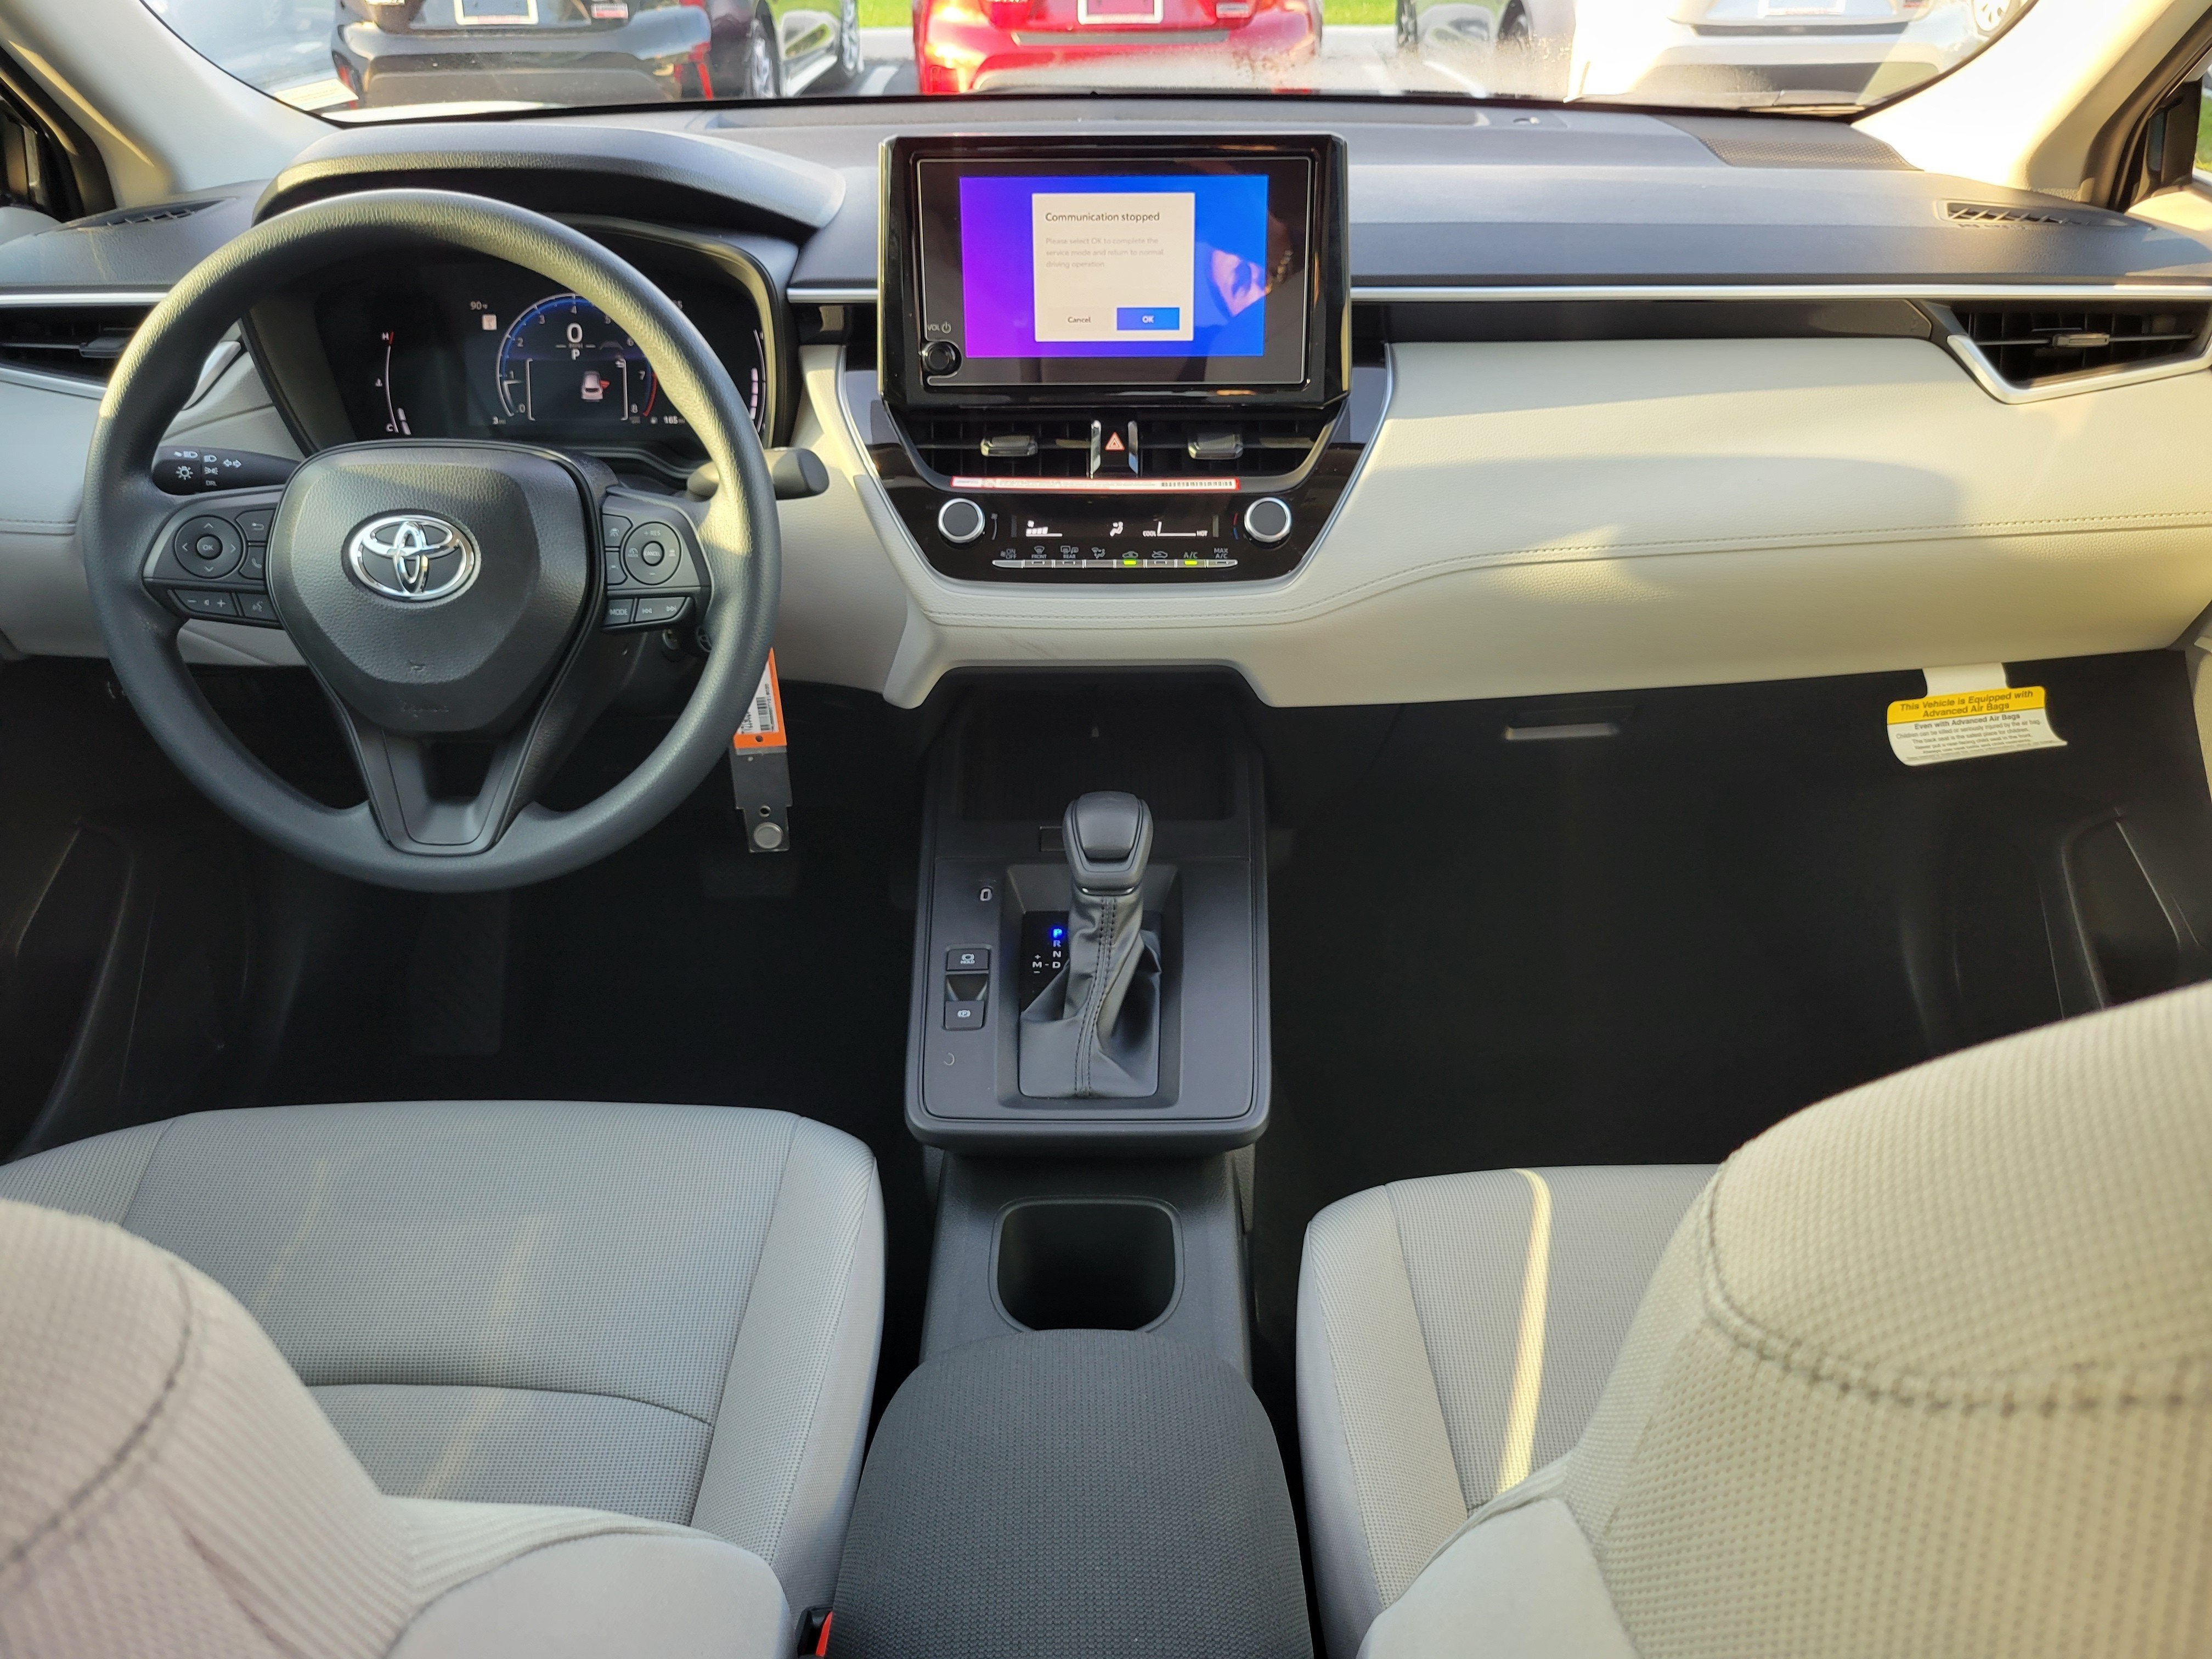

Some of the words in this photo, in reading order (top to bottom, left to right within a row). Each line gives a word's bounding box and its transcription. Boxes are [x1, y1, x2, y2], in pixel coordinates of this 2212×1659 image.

[1045, 212, 1119, 222] Communication
[1121, 212, 1160, 223] stopped
[1142, 315, 1154, 324] OK
[567, 323, 583, 343] 0
[517, 337, 524, 347] 2
[571, 349, 580, 360] P
[510, 370, 514, 379] 1
[639, 370, 646, 380] 7
[518, 403, 526, 413] 0
[386, 423, 393, 432] C
[1922, 699, 1955, 708] Vehicle
[1968, 692, 2012, 704] Equipped
[2015, 690, 2033, 699] with
[1922, 706, 1968, 718] Advanced
[1971, 703, 1984, 712] Air
[1987, 702, 2010, 712] Bags
[1952, 716, 1987, 725] Advanced
[1053, 929, 1063, 938] P
